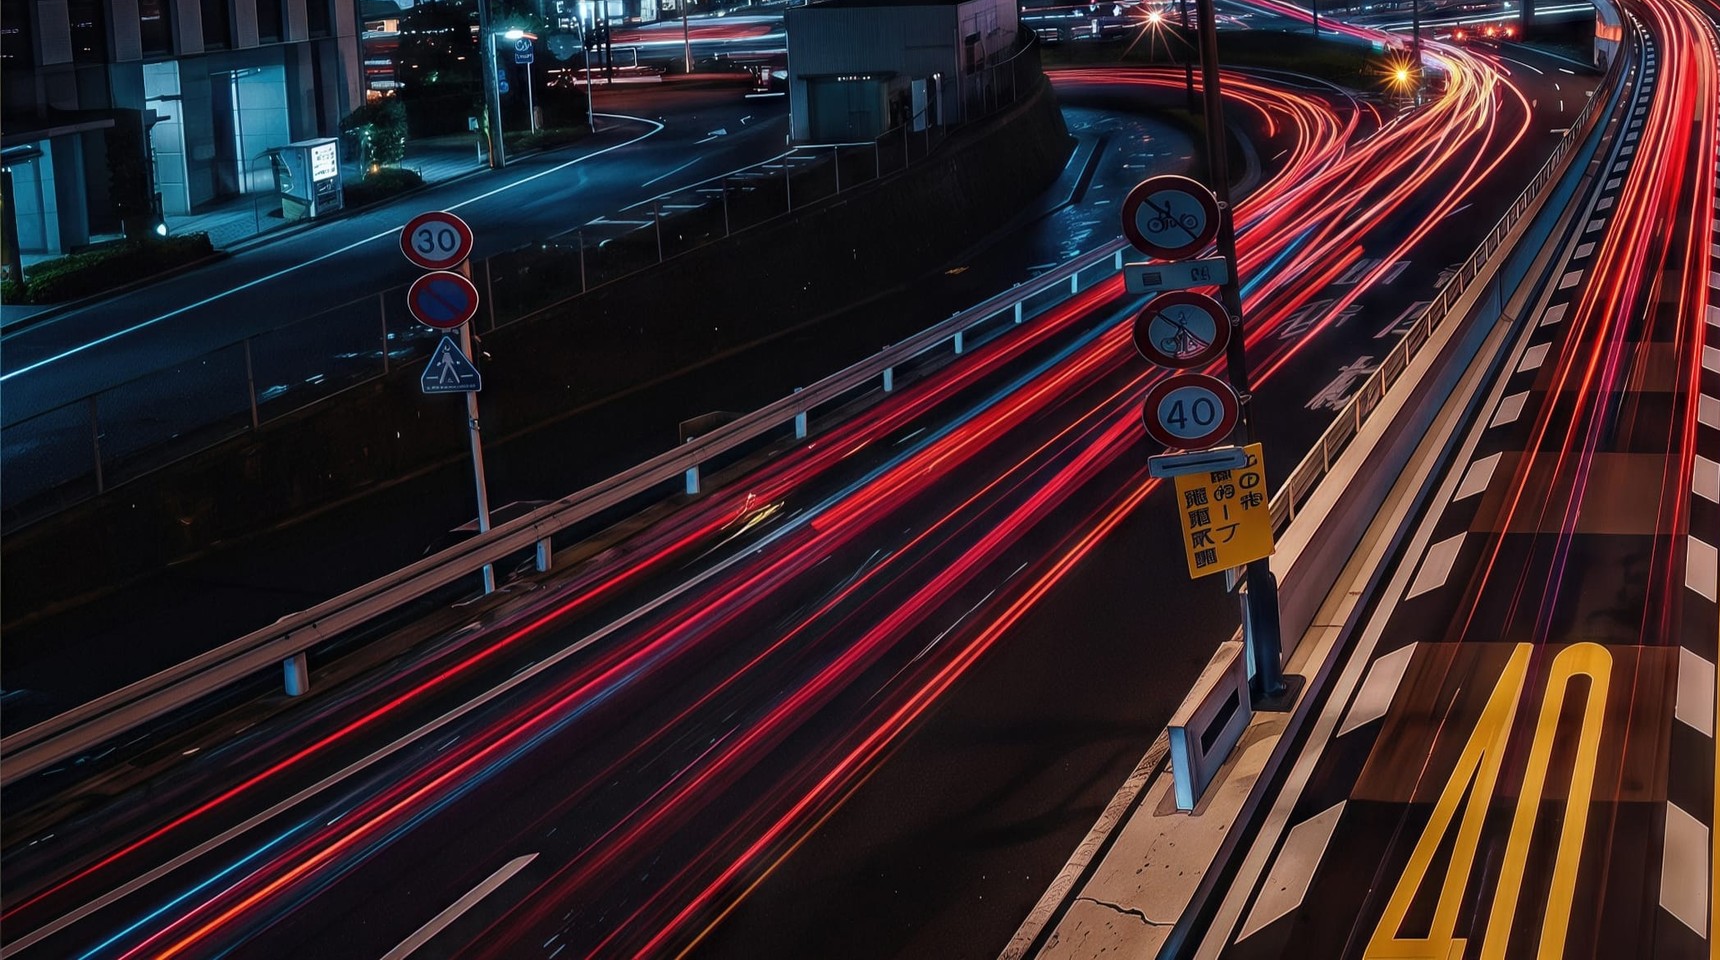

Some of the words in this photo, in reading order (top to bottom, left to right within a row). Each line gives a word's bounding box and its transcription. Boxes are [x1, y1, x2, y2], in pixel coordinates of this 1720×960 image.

[418, 229, 456, 253] 30
[1167, 397, 1216, 429] 40
[1363, 642, 1613, 960] 40
